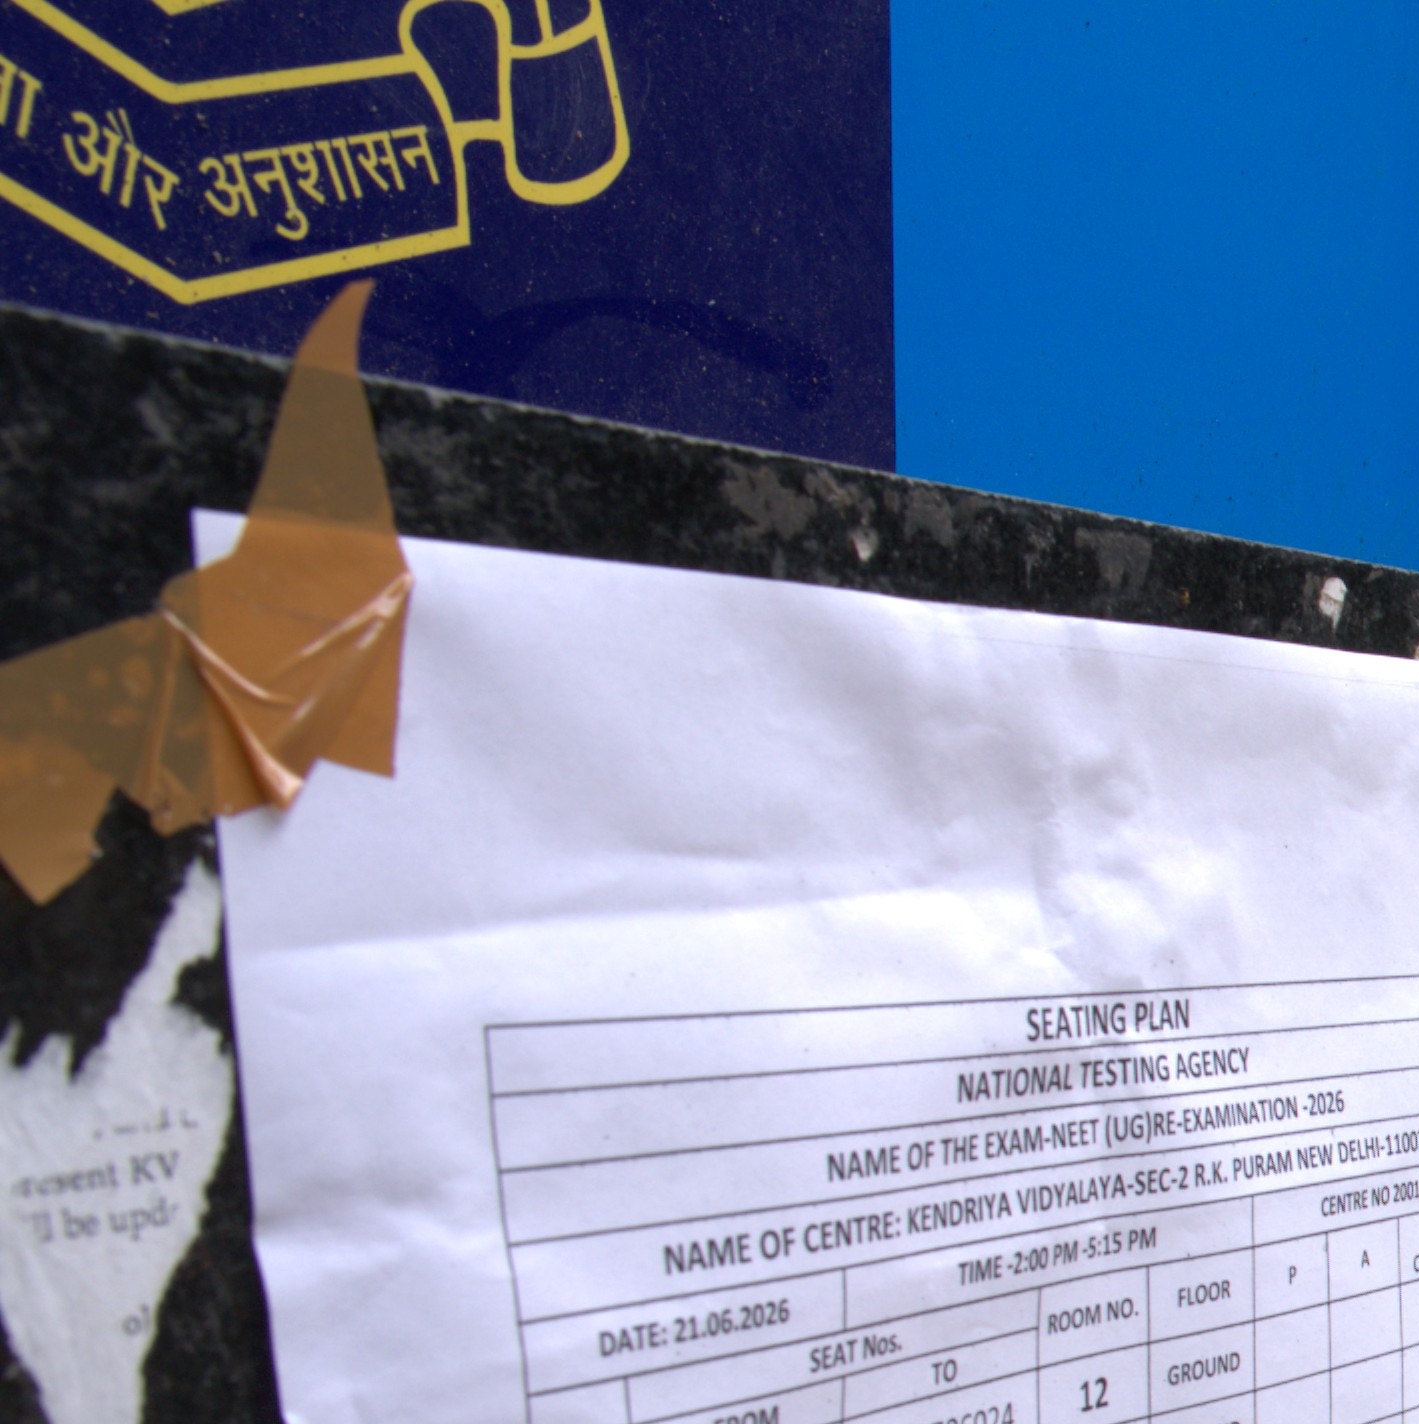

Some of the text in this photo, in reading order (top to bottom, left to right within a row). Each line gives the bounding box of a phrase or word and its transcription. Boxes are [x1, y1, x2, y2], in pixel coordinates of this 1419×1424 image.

[62, 106, 441, 242] और अनुशासन
[1026, 998, 1190, 1043] SEATING PLAN
[957, 1046, 1250, 1103] NATIONAL TESTING AGENCY
[129, 1151, 180, 1185] KV
[826, 1145, 901, 1183] NAME
[907, 1140, 935, 1171] OF
[940, 1134, 979, 1166] THE
[985, 1118, 1100, 1160] EXAM-NEET
[663, 1233, 752, 1276] NAME
[759, 1226, 796, 1261] OF
[803, 1211, 901, 1254] CENTRE:
[907, 1191, 1012, 1235] KENDRIYA
[1016, 1165, 1189, 1214] VIDYALAYA-SEC-2
[1194, 1160, 1228, 1188] R.K.
[1232, 1149, 1293, 1181] PURAM
[1296, 1143, 1333, 1170] NEW
[598, 1322, 668, 1358] DATE:
[673, 1298, 790, 1344] 21.06.2026
[958, 1255, 1003, 1286] TIME
[1053, 1240, 1079, 1266] PM
[1127, 1226, 1157, 1251] PM
[1321, 1189, 1368, 1218] CENTRE
[1371, 1185, 1390, 1207] NO
[931, 1359, 958, 1385] TO
[1047, 1304, 1101, 1335] ROOM
[1106, 1297, 1139, 1322] NO.
[1177, 1280, 1231, 1308] FLOOR
[1288, 1265, 1297, 1285] P
[1361, 1250, 1370, 1268] A
[809, 1334, 902, 1373] SEAT Nos.
[1080, 1377, 1109, 1413] 12
[1167, 1352, 1240, 1386] GROUND
